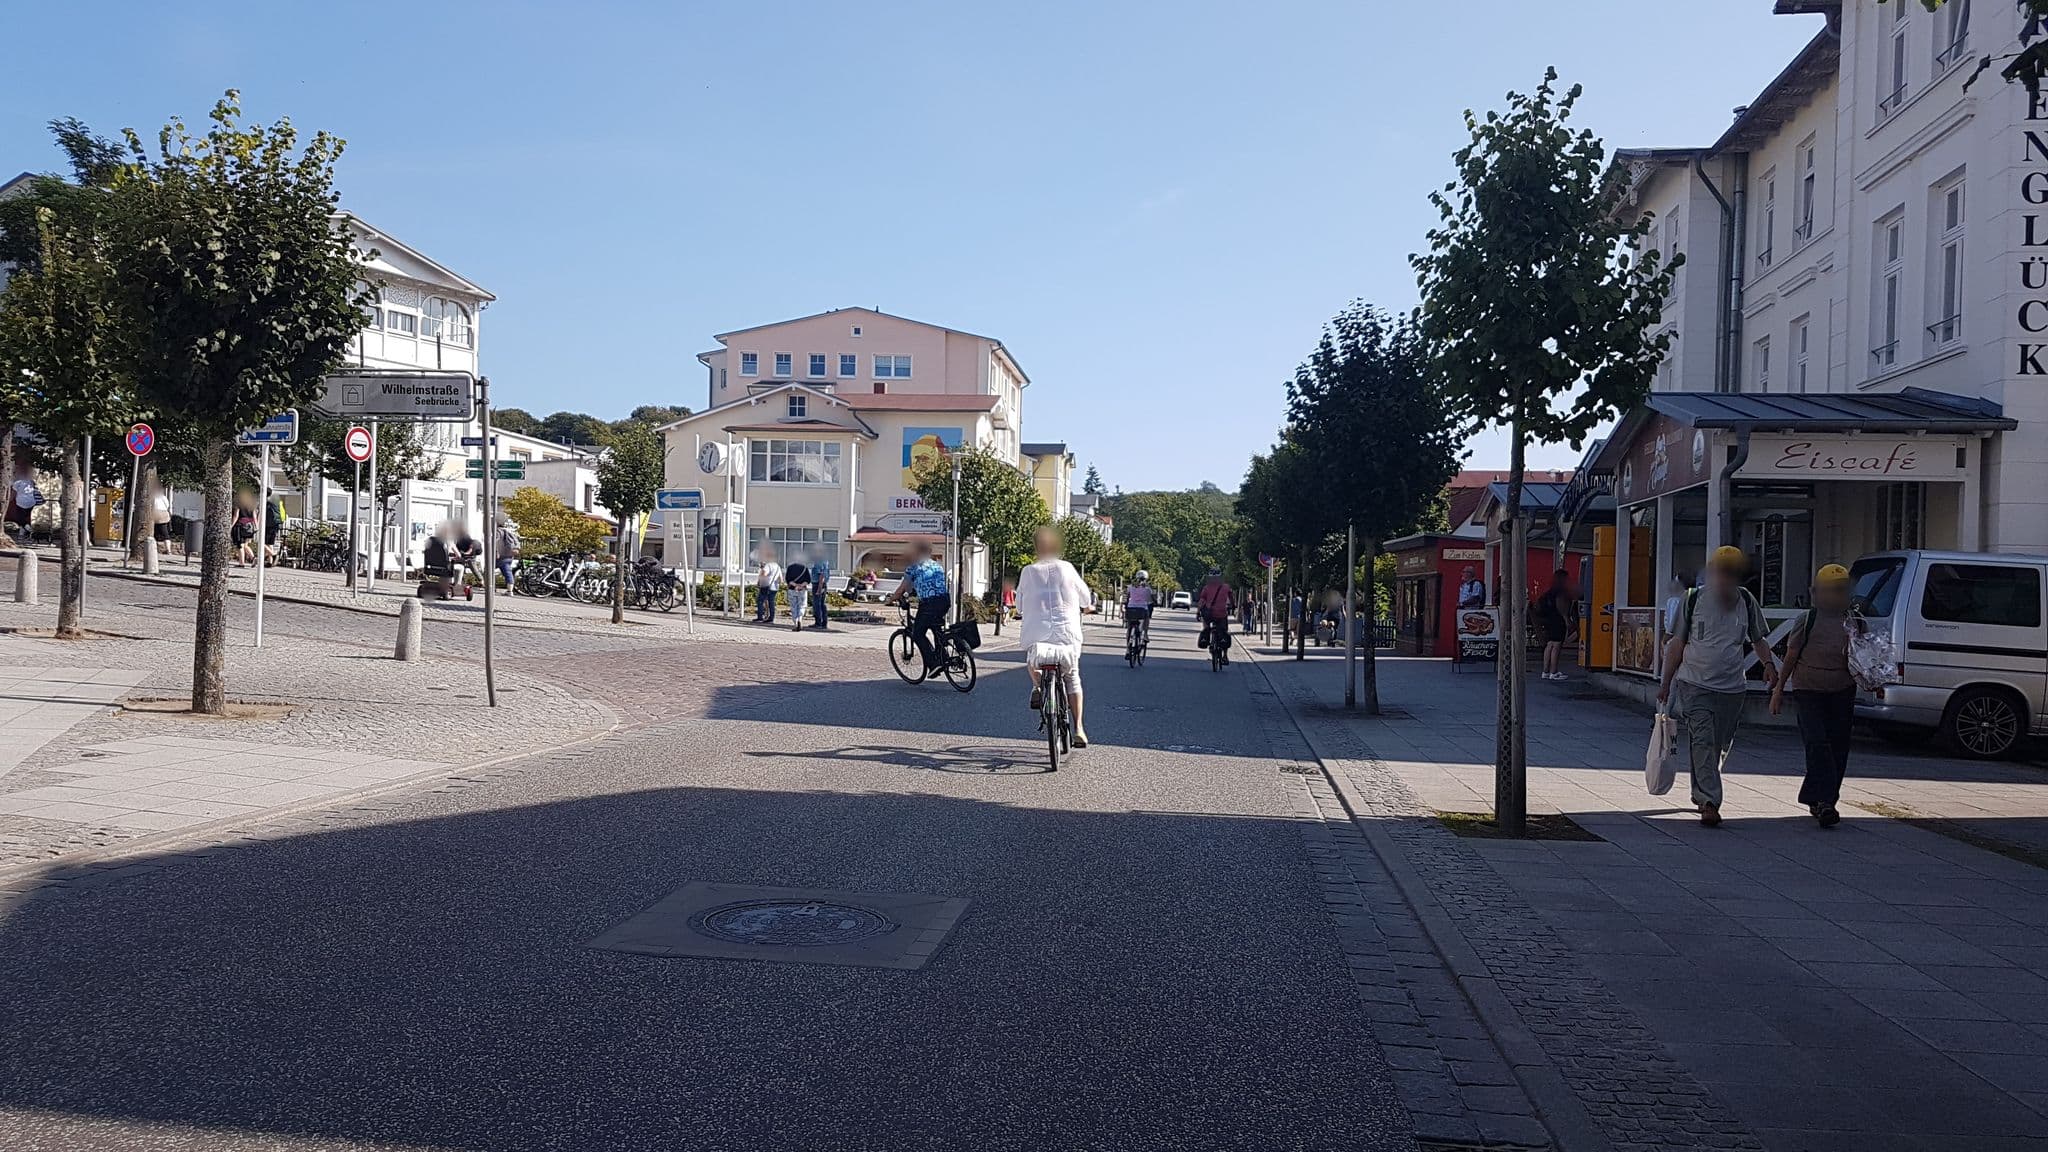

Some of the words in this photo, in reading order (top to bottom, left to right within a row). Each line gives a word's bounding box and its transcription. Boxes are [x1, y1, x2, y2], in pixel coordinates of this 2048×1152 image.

[381, 383, 459, 395] Wilhelmstraße
[415, 396, 459, 406] Seebrücke
[1775, 442, 1918, 474] Eiscafé
